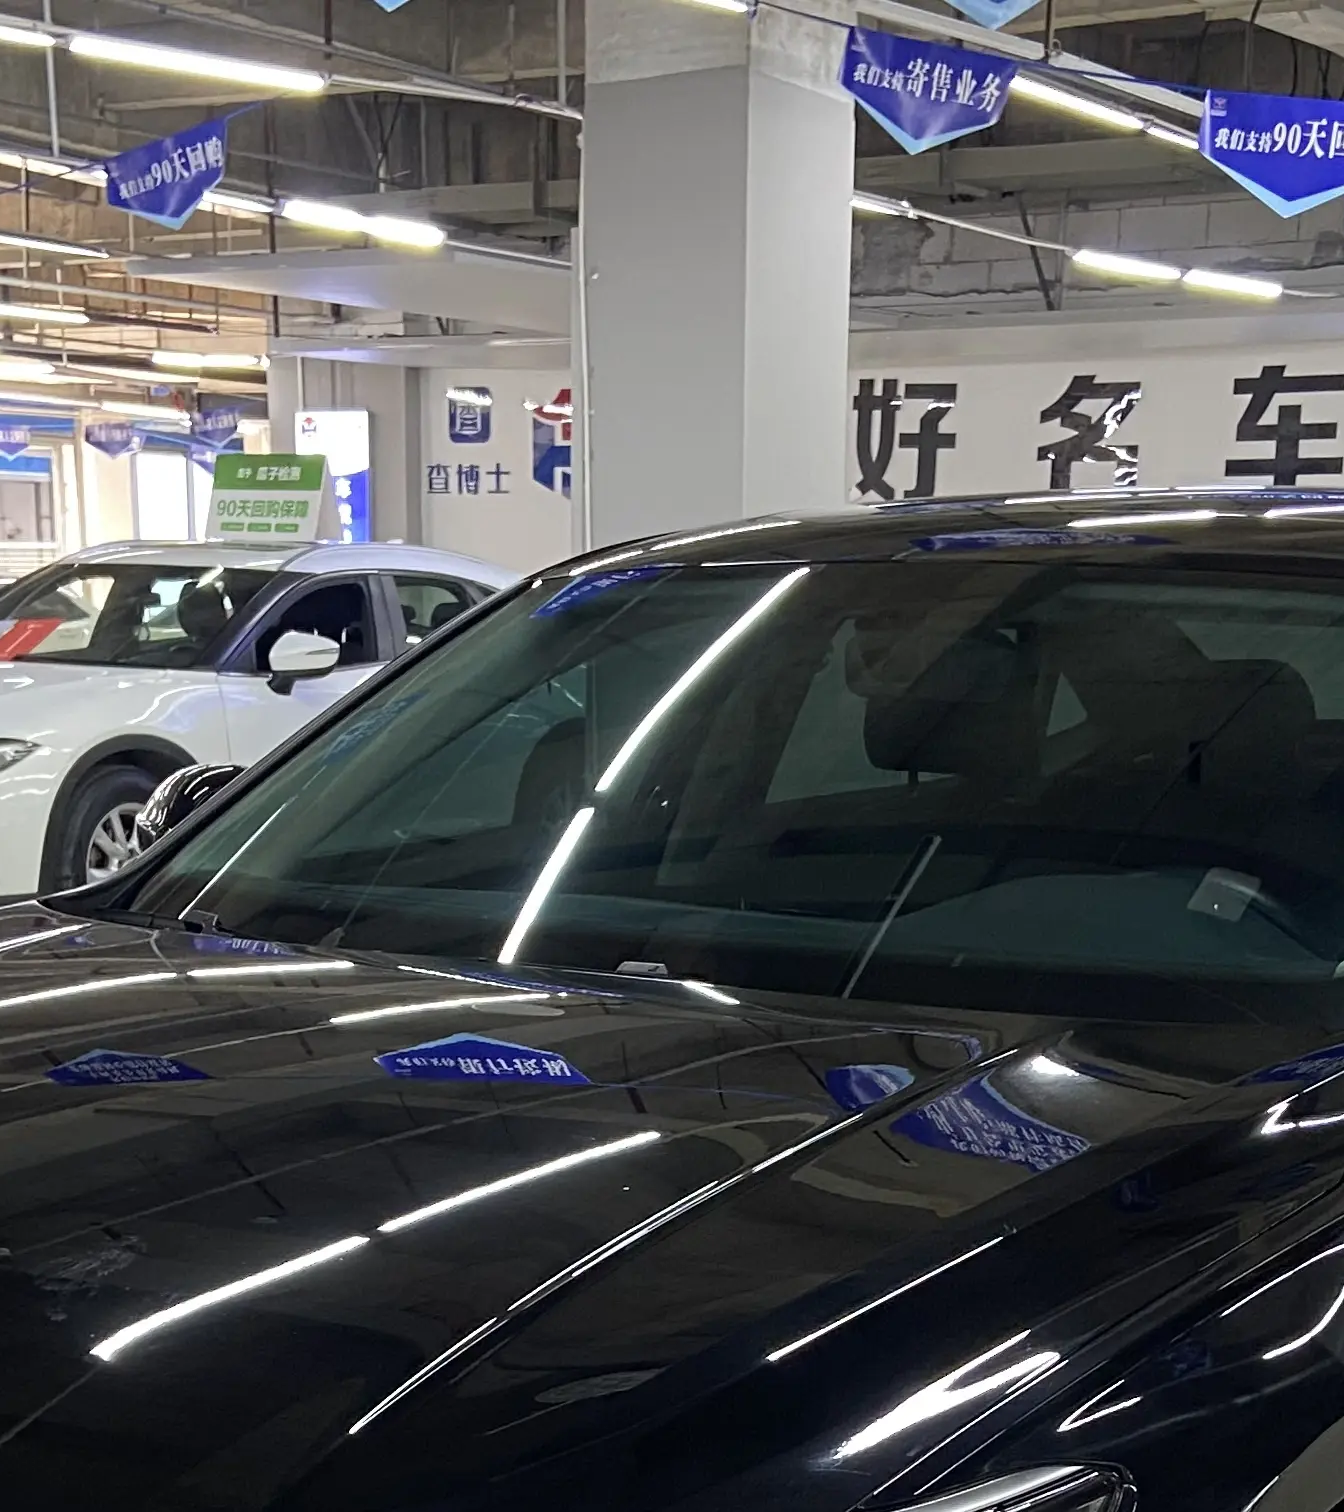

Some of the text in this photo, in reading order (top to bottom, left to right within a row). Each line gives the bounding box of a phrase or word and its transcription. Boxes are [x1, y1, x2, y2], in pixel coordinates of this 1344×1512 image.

[853, 57, 1002, 113] 我们支持寄售业务
[427, 463, 511, 495] 查博士
